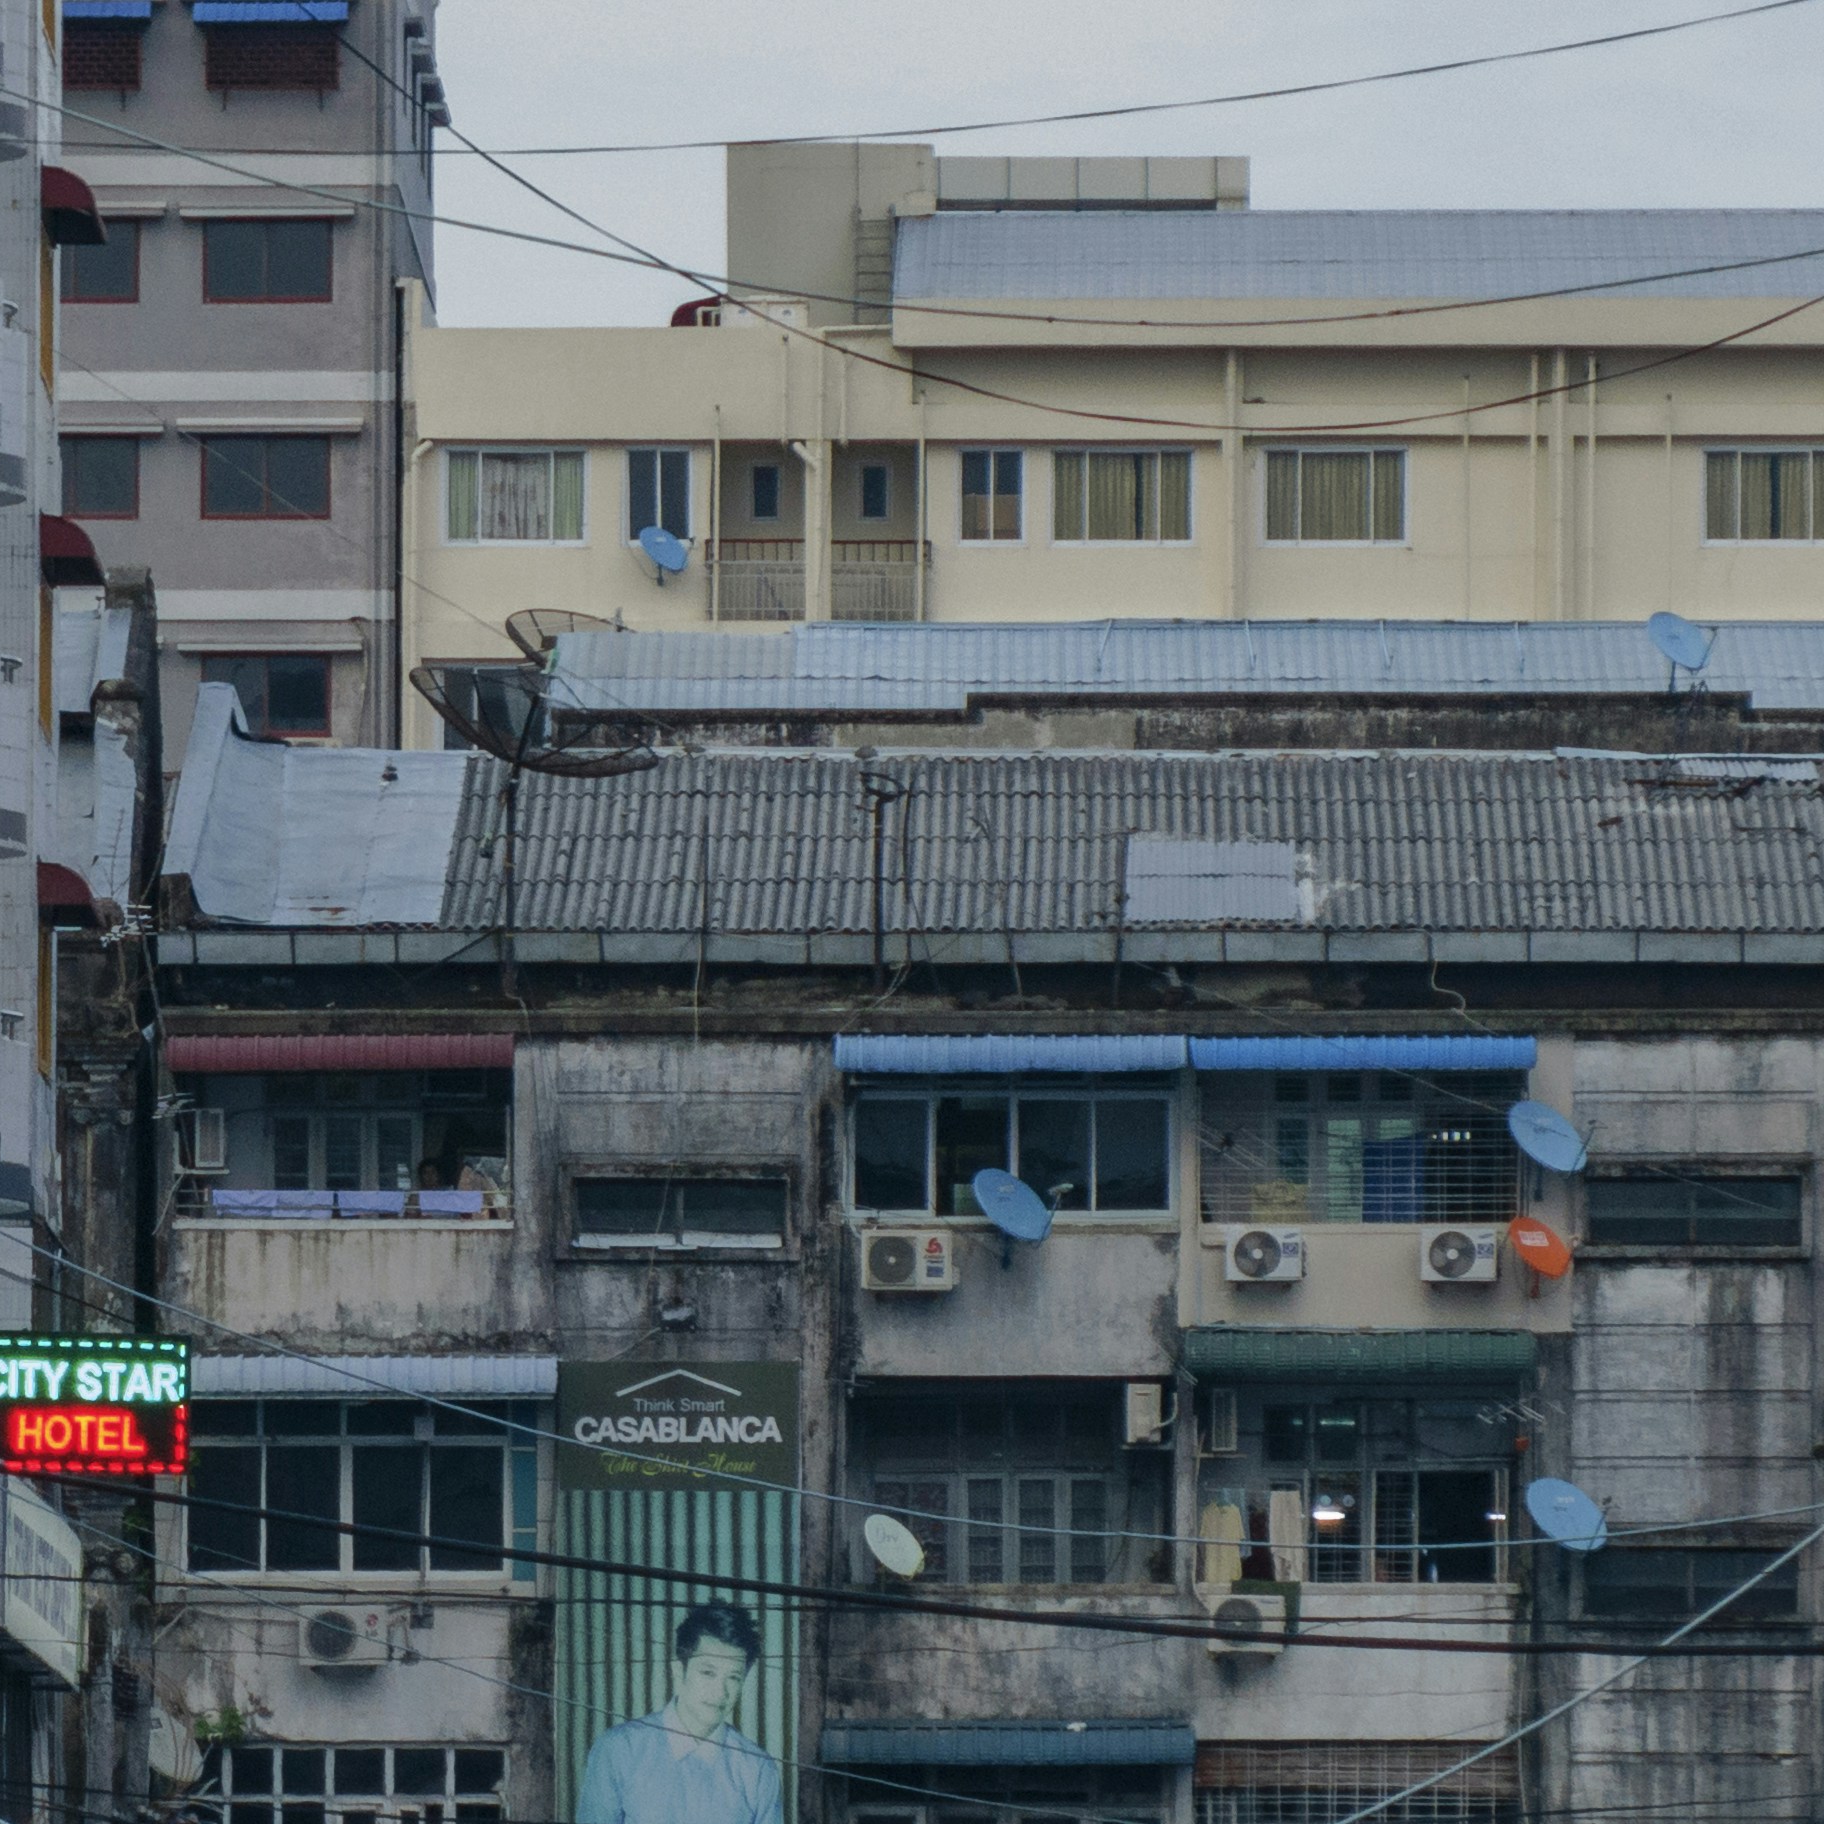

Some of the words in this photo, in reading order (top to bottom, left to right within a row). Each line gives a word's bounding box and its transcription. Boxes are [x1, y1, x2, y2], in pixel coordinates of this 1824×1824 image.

[76, 1360, 181, 1402] STAR
[633, 1397, 675, 1413] Think
[679, 1397, 726, 1413] Smart
[15, 1412, 146, 1452] HOTEL
[574, 1416, 783, 1444] CASABLANCA
